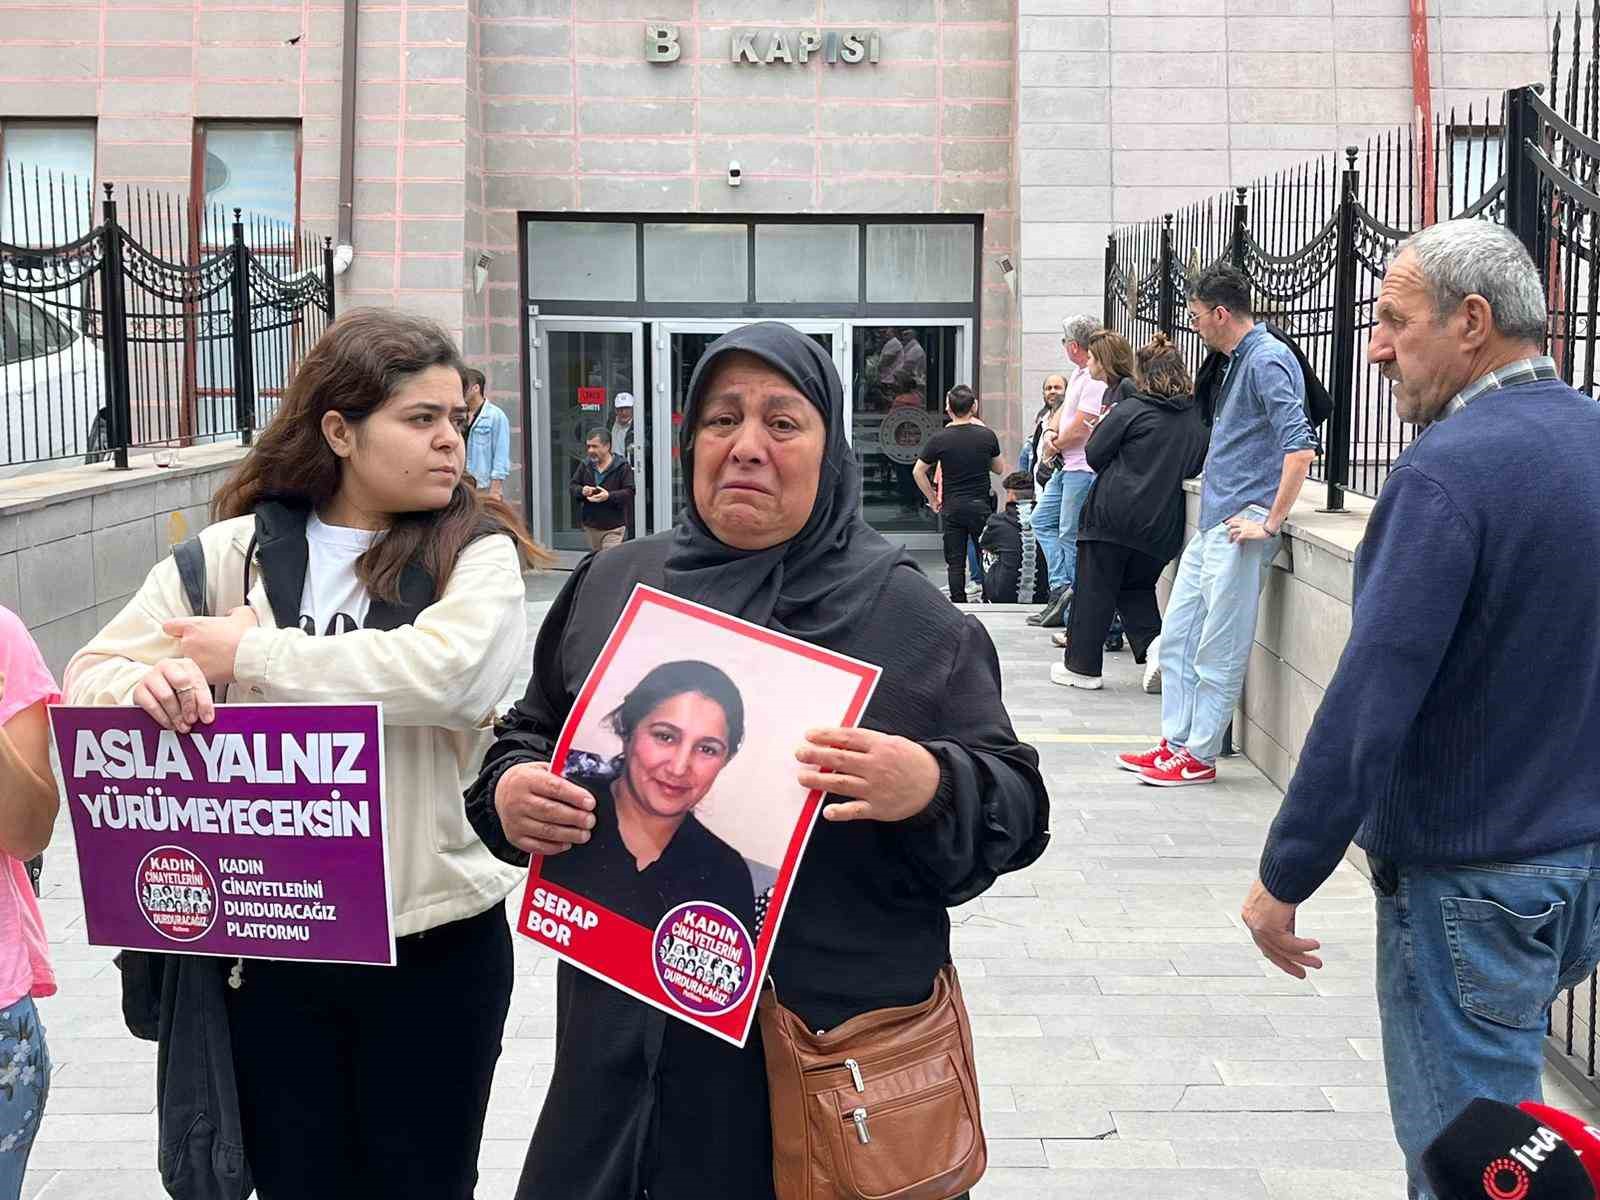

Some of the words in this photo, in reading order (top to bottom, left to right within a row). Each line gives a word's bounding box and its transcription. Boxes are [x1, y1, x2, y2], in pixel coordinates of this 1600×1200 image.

[645, 22, 681, 64] B
[731, 30, 880, 65] KAPISI
[73, 728, 193, 781] ASLA
[190, 732, 367, 785] YALNIZ
[78, 785, 371, 838] YÜRÜMEYECEKSİN
[150, 857, 195, 873] KADIN
[218, 858, 264, 875] KADIN
[221, 876, 324, 899] CİNAYETLERİNİ
[224, 900, 337, 921] DURDURACAĞIZ
[531, 887, 599, 931] SERAP
[683, 909, 739, 946] KADIN
[227, 922, 310, 941] PLATFORMU
[526, 911, 572, 947] BOR
[671, 921, 743, 963] CİNAYETLERİNİ
[1509, 1126, 1563, 1173] İHA
